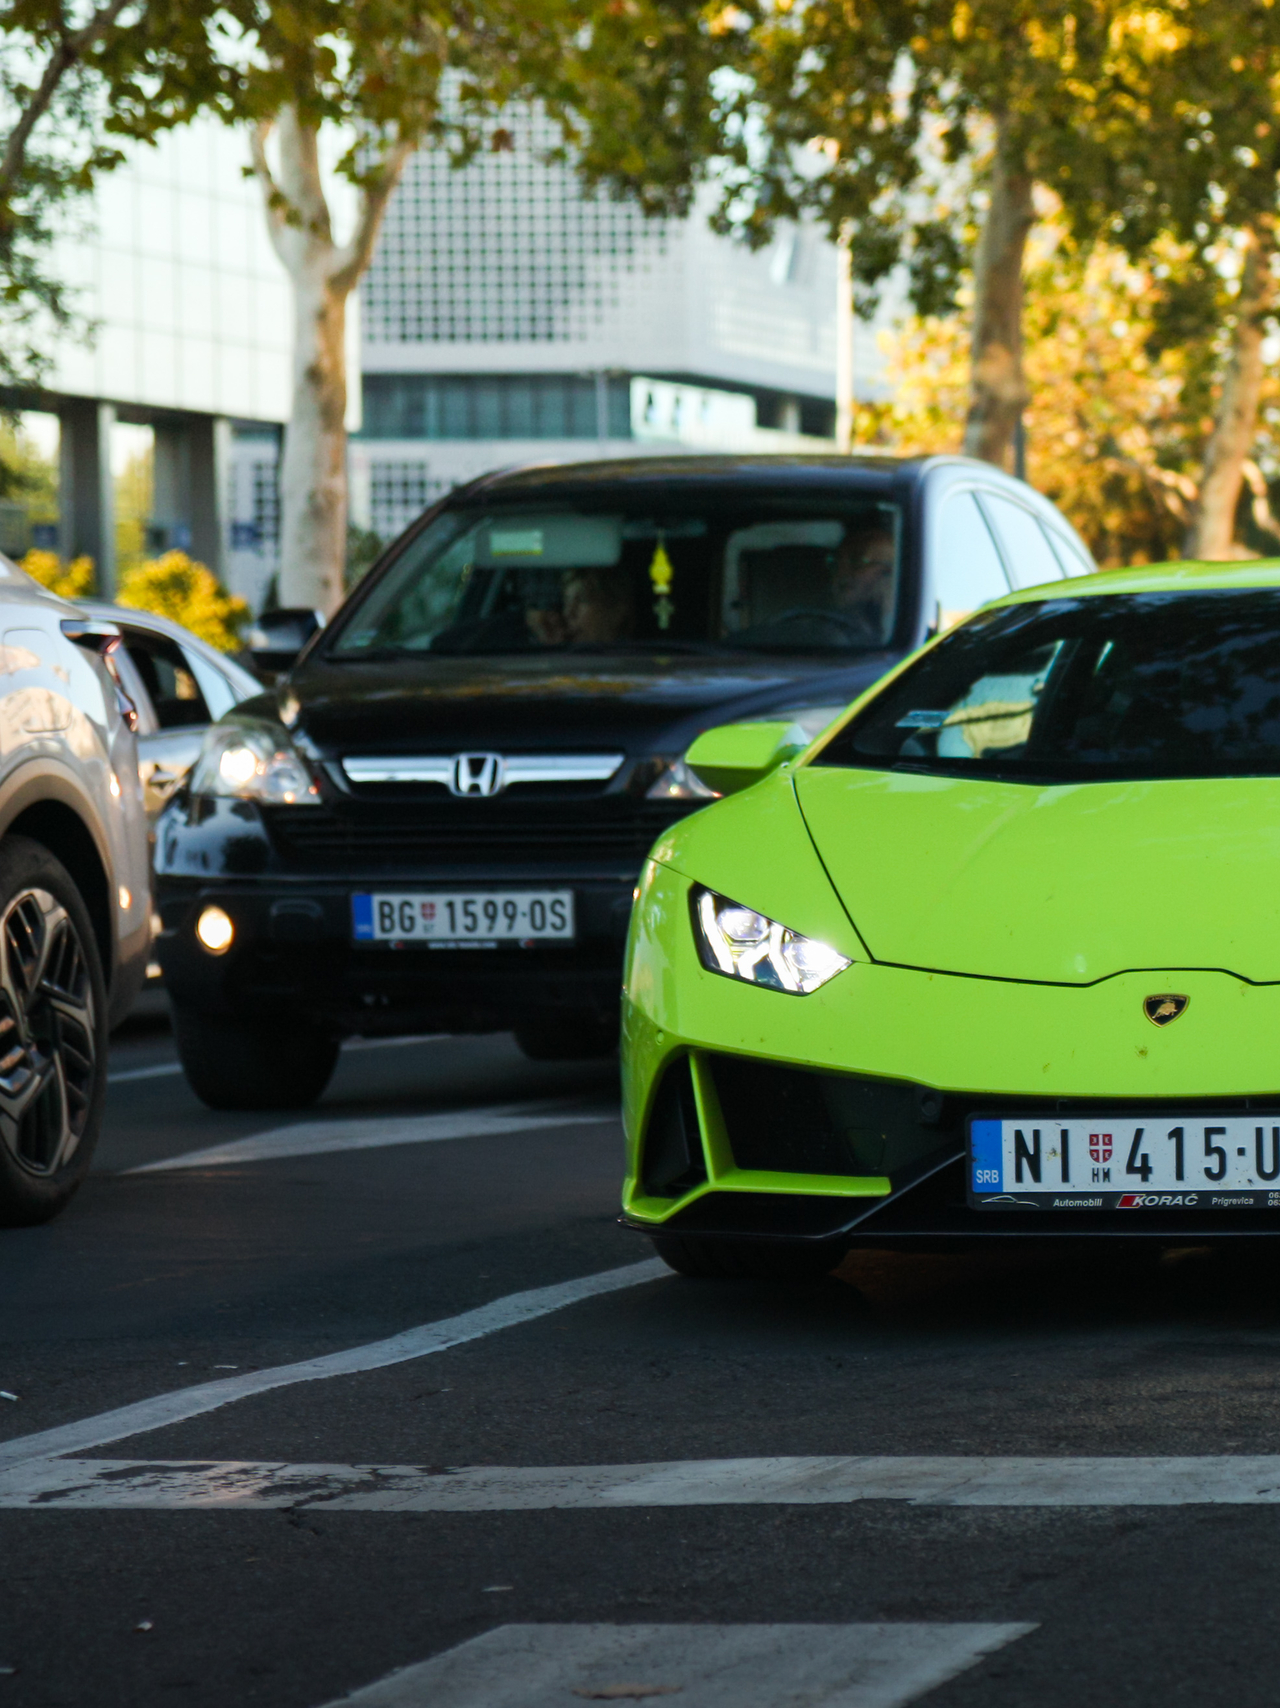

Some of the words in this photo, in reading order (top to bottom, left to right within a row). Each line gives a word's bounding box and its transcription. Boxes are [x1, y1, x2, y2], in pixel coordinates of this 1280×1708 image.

[378, 901, 416, 933] BG
[1014, 1129, 1069, 1183] NI
[976, 1169, 999, 1183] SRB
[1053, 1198, 1102, 1207] Automobili
[1211, 1197, 1254, 1206] Prigrevica
